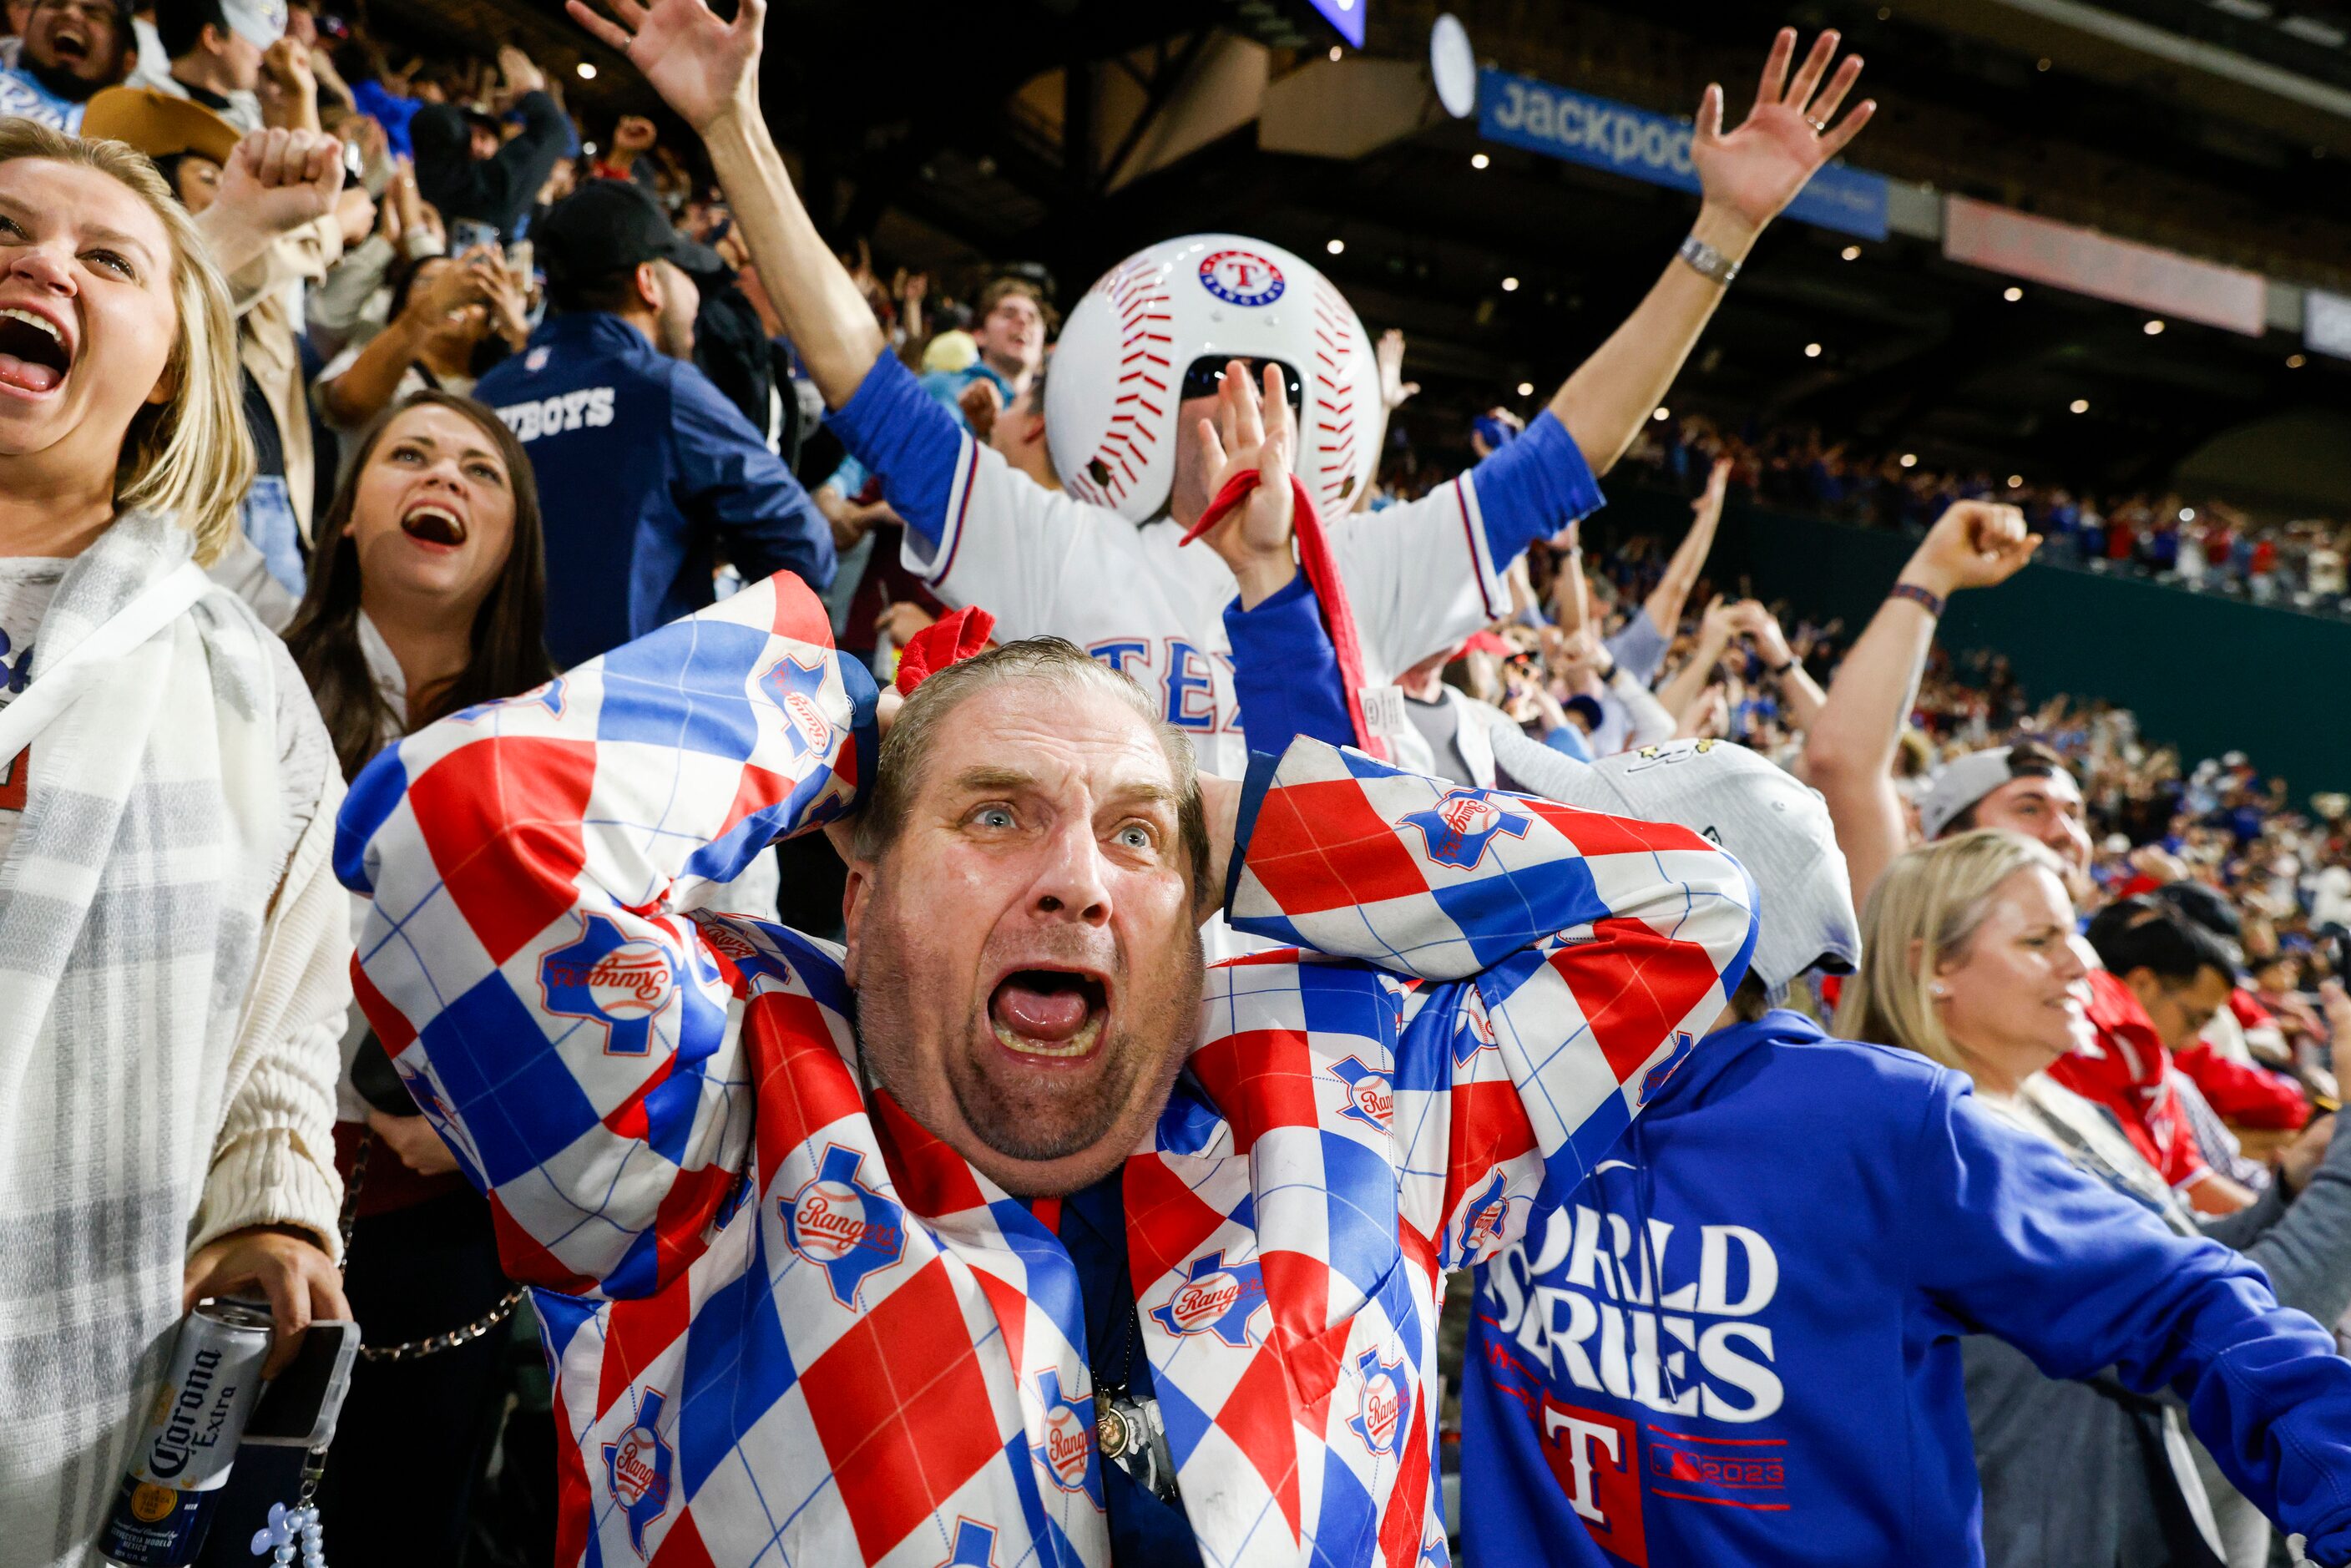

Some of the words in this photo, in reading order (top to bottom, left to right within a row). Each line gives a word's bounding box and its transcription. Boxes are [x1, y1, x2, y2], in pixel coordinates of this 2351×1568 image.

[1226, 264, 1258, 286] T
[1435, 799, 1489, 859] Rangers
[547, 958, 668, 1001] Rangers
[796, 1196, 898, 1256] Rangers
[149, 1348, 222, 1479] Corona
[186, 1386, 237, 1454] Extra
[1544, 1404, 1620, 1525] T
[1703, 1462, 1784, 1483] 2023
[123, 1540, 148, 1552] MEXICO
[144, 1537, 173, 1548] MODELO
